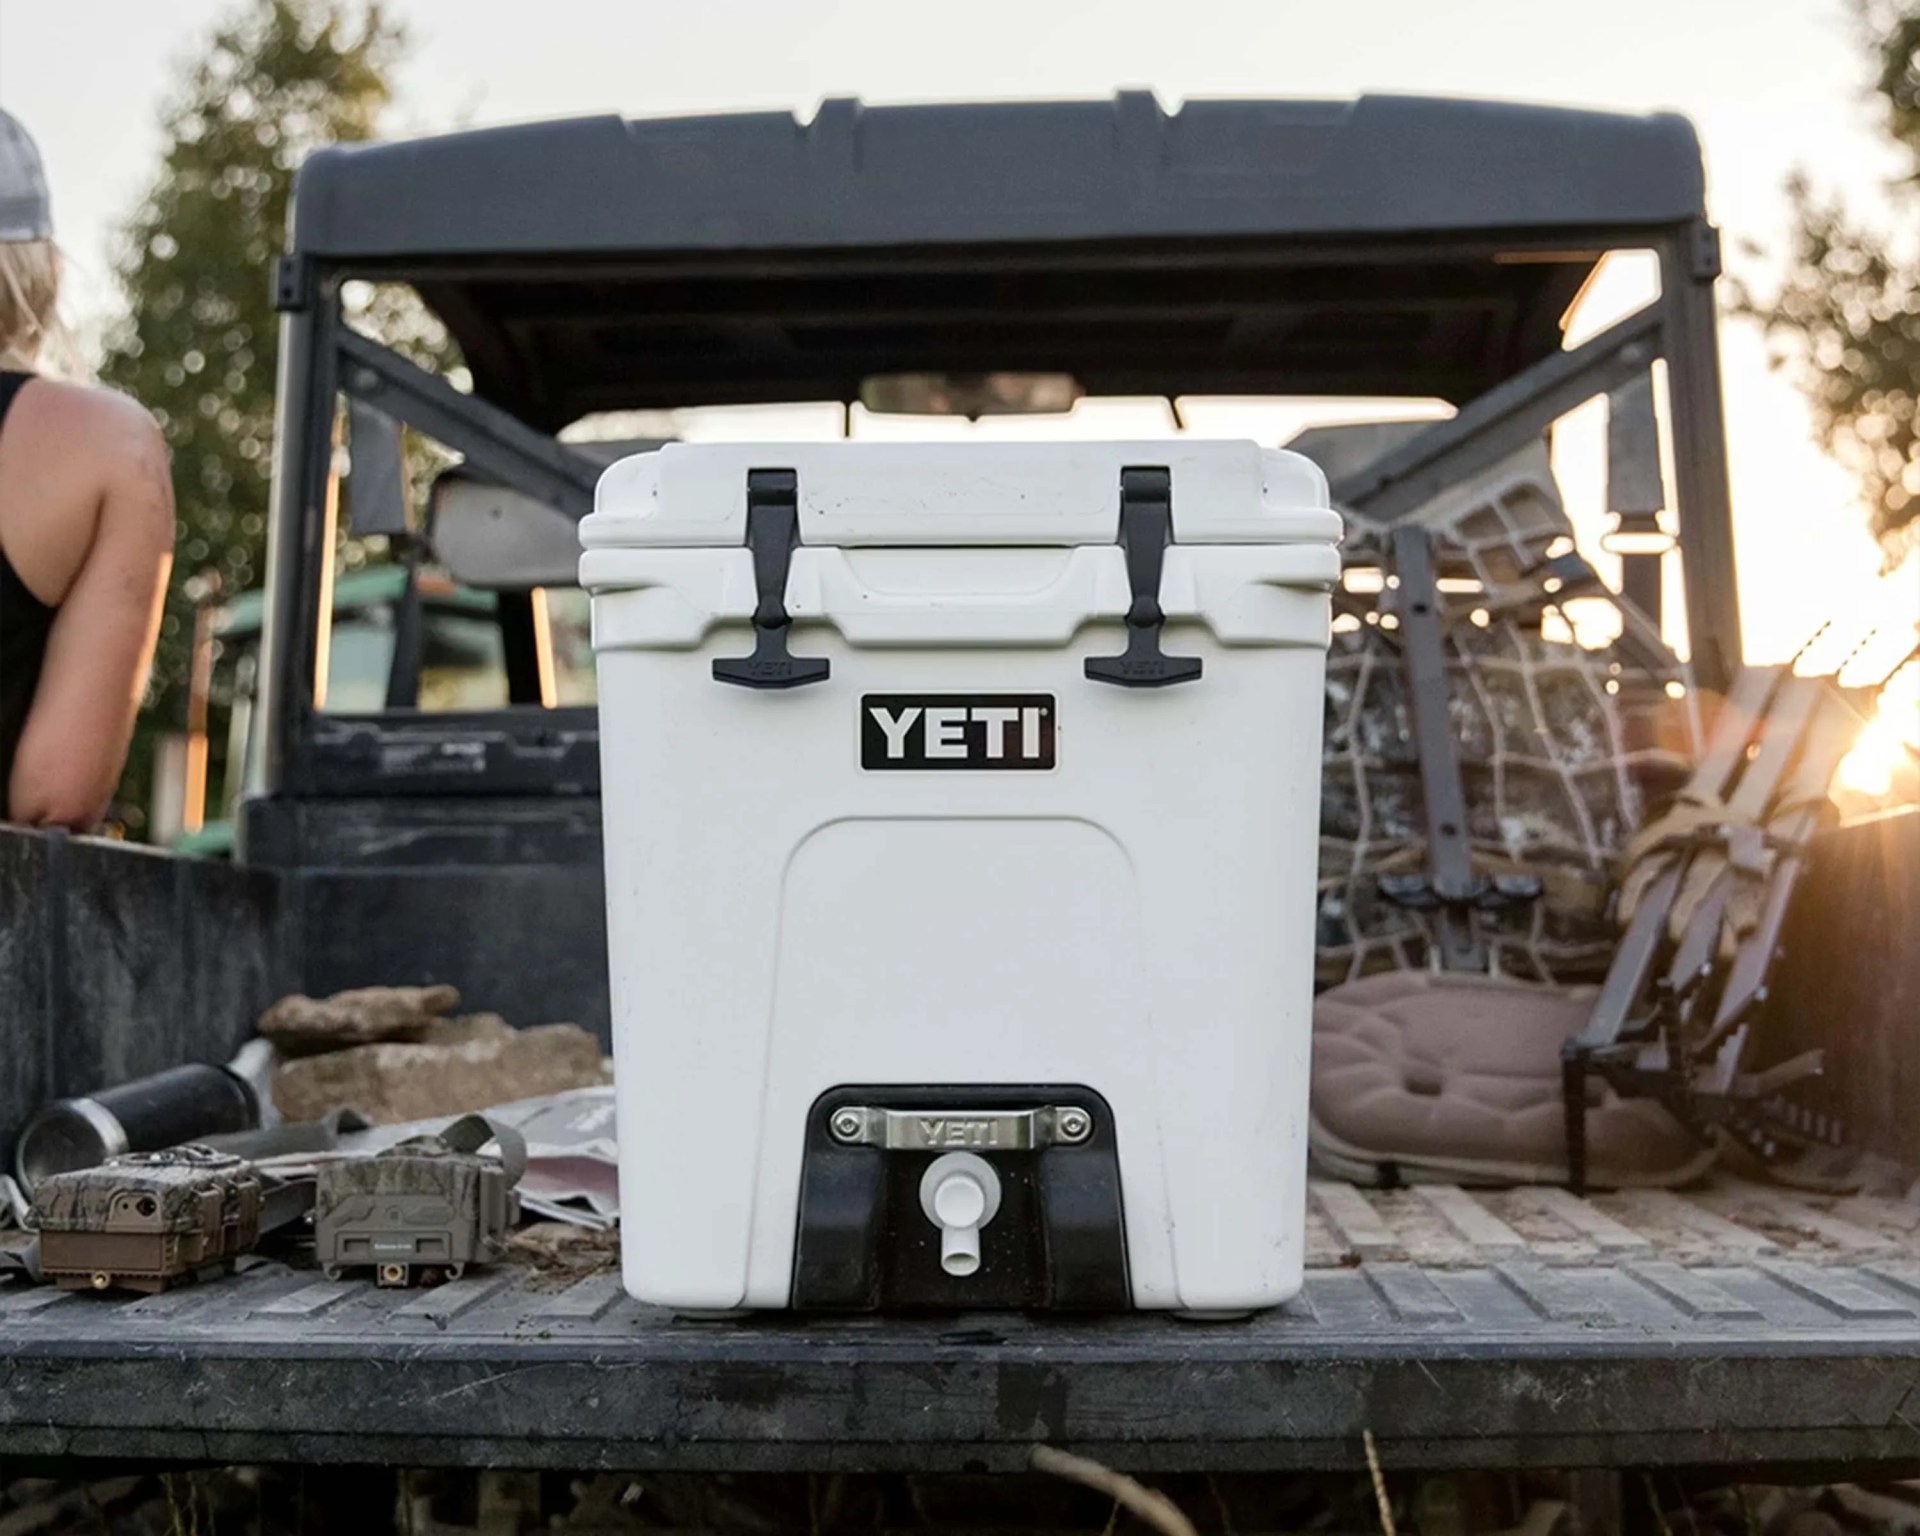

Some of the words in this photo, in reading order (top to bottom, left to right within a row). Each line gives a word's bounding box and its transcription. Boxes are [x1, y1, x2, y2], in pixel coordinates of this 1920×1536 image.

[748, 661, 793, 676] YETI
[1119, 660, 1165, 675] YETI
[868, 707, 1041, 759] YETI
[920, 1119, 998, 1146] YETI
